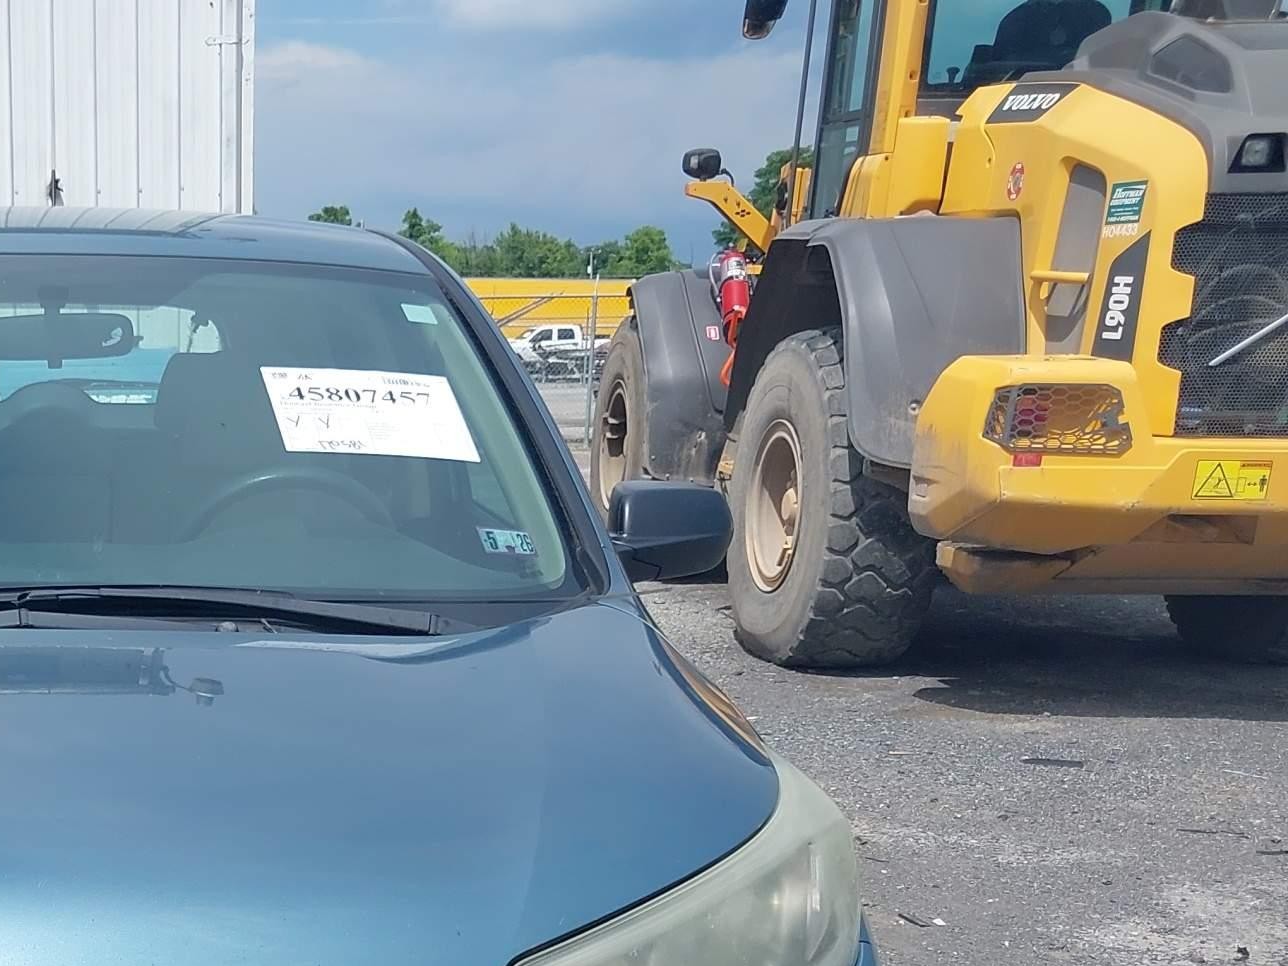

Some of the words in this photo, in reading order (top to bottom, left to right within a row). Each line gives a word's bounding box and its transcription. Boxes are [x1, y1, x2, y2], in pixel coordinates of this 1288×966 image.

[1002, 92, 1061, 111] VOLVO
[1102, 276, 1134, 340] L90H
[289, 386, 430, 407] 45807457
[516, 533, 534, 552] 26
